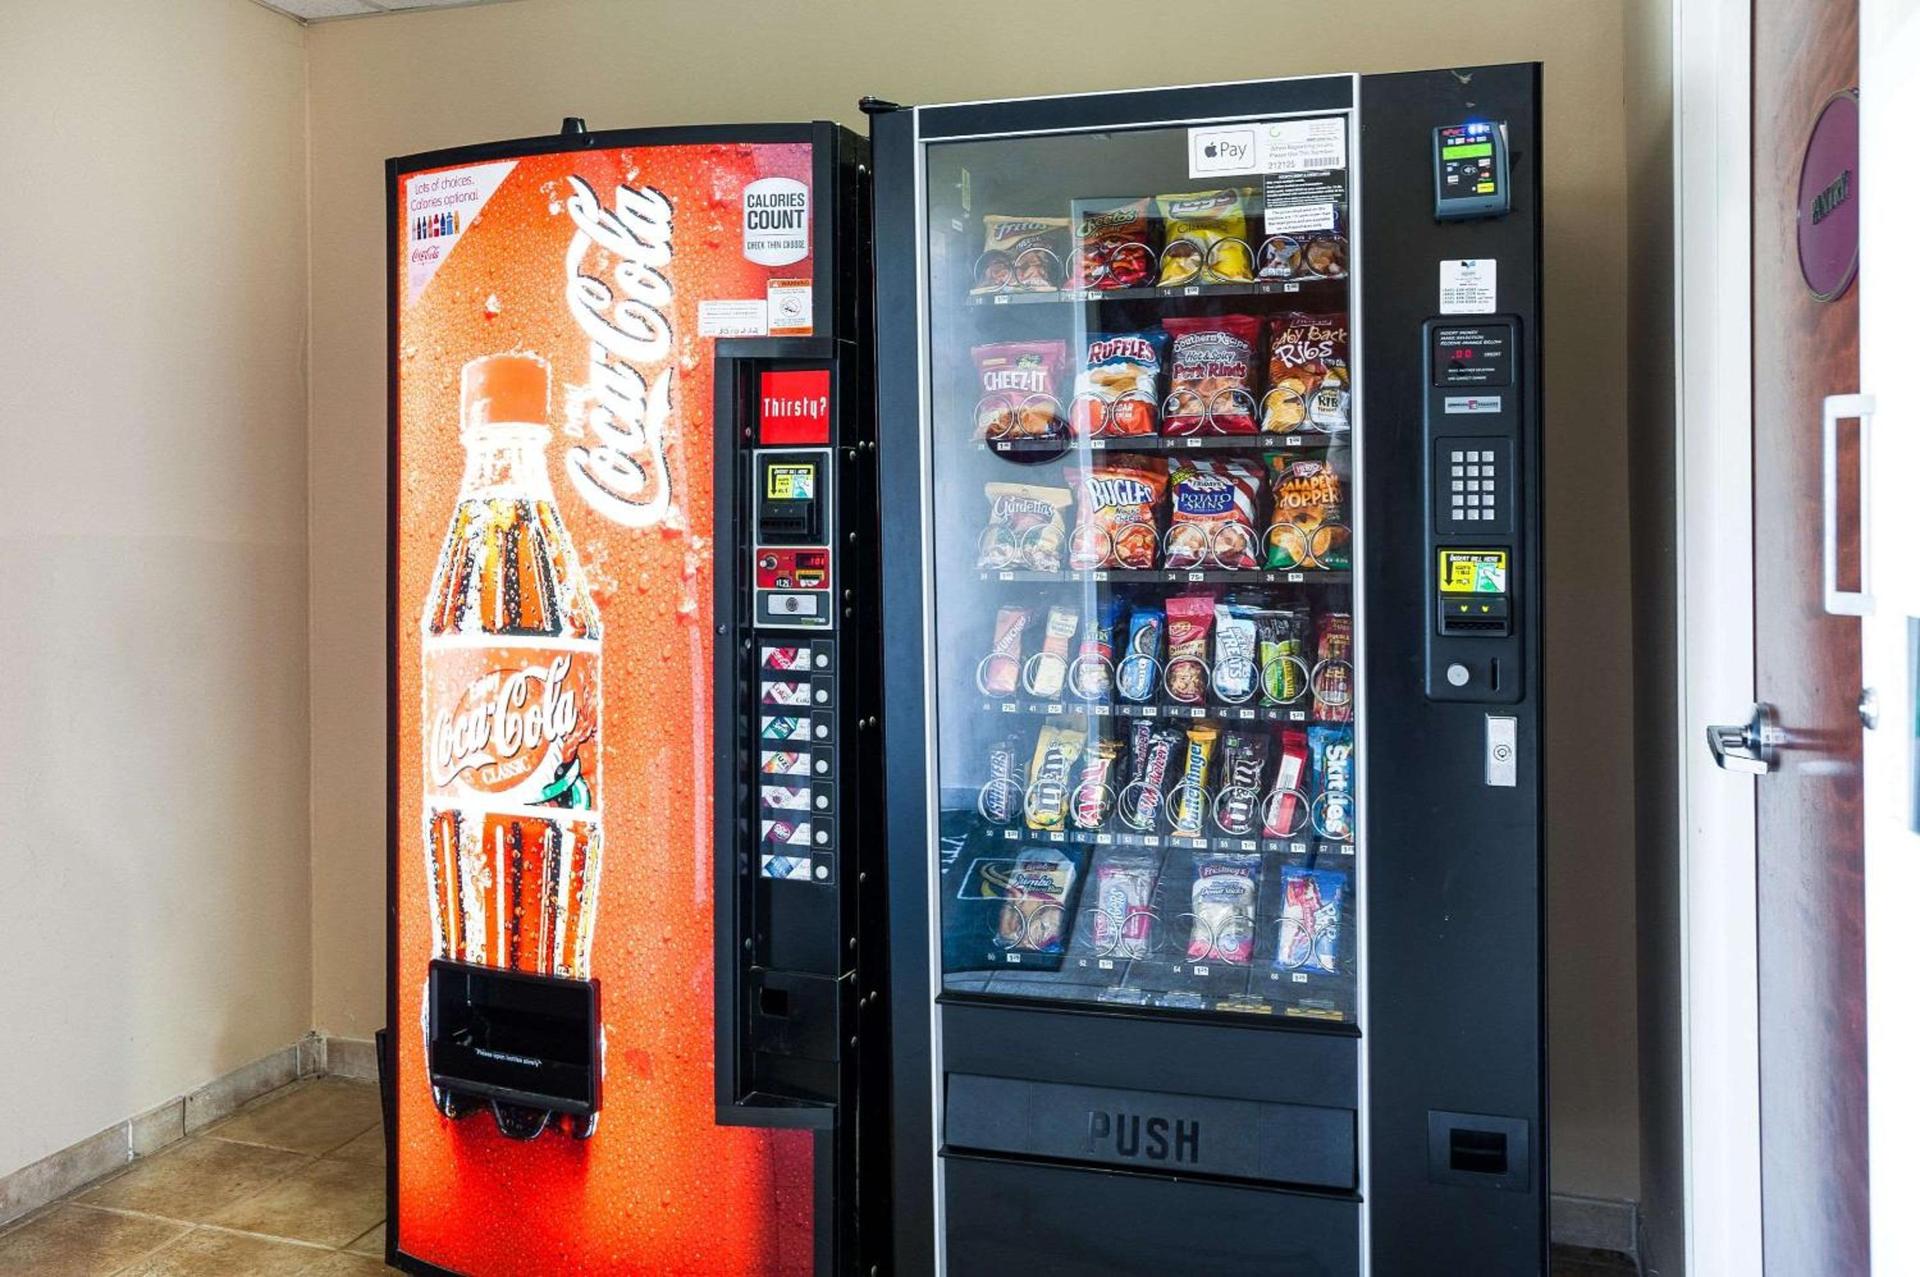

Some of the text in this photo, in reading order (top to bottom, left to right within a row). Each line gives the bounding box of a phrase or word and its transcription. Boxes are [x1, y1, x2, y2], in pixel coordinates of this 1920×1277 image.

[1220, 141, 1248, 160] Pay
[415, 183, 430, 195] Lots
[431, 178, 440, 192] of
[410, 197, 442, 211] Calories
[747, 193, 805, 209] CALORIES
[747, 209, 805, 230] COUNT
[1076, 208, 1138, 238] Cheetos
[994, 222, 1048, 241] Fritos
[1174, 333, 1249, 352] Southern Recipe
[1307, 325, 1347, 344] Back
[1088, 337, 1156, 363] RUFFLES
[1275, 340, 1334, 368] Ribs
[1172, 361, 1247, 379] Pork Rinds
[763, 396, 827, 420] Thirsty?
[1280, 474, 1339, 493] JALAPE
[1086, 477, 1152, 513] BUGLES
[1181, 493, 1232, 503] POTATO
[1186, 501, 1224, 510] SKINS
[1449, 554, 1470, 562] INSERT
[1217, 629, 1242, 679] TREATS
[429, 652, 580, 789] Coca-Cola
[482, 758, 531, 784] CLASSIC
[1178, 742, 1208, 831] Butterfinger
[1325, 744, 1348, 833] Skittles
[1012, 873, 1054, 889] Jumbo
[1087, 1111, 1199, 1164] PUSH
